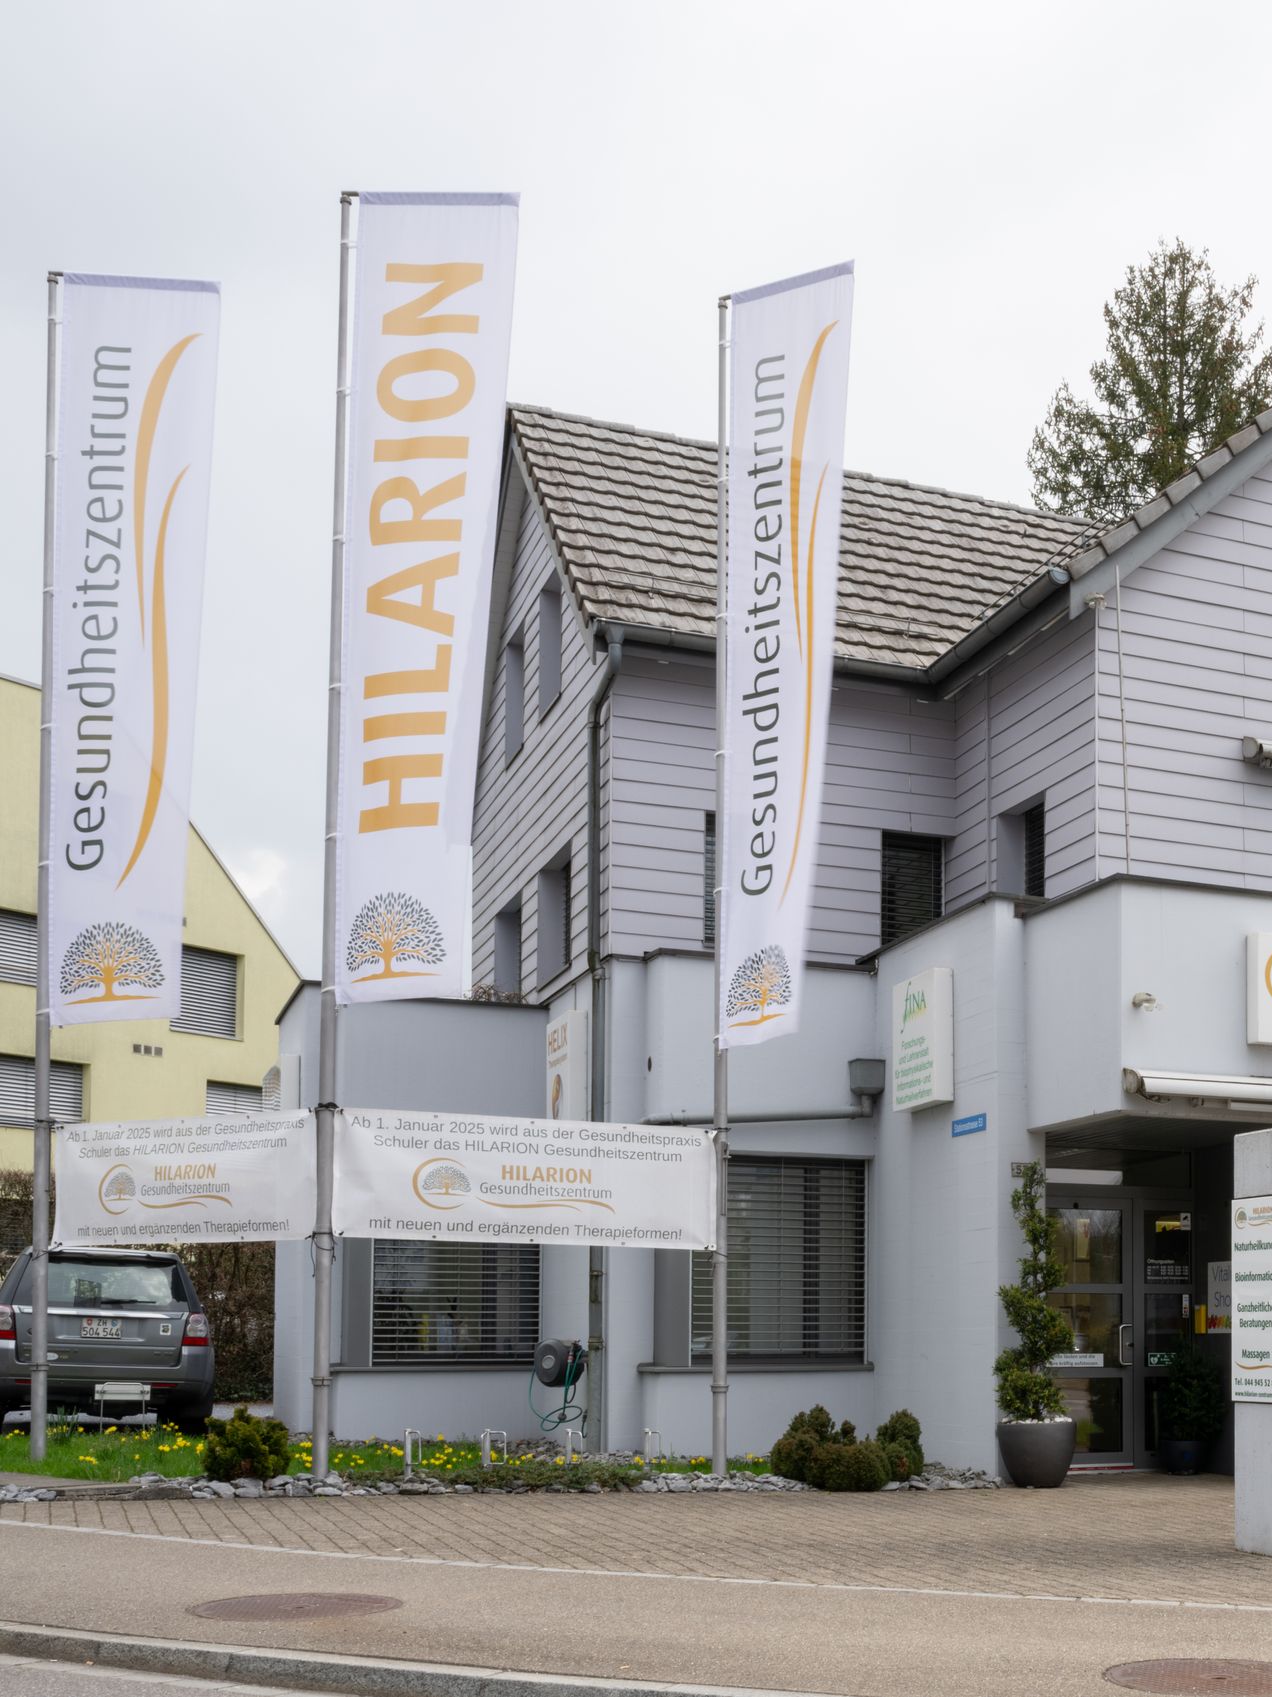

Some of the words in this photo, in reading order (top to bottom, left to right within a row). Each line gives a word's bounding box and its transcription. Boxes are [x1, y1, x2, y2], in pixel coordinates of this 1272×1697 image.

[357, 261, 485, 835] HILARION
[65, 345, 132, 872] Gesundheitszentrum
[740, 353, 786, 896] Gesundheitszentrum
[66, 1130, 80, 1143] Ab
[82, 1131, 90, 1142] 1.
[92, 1129, 125, 1142] Januar
[127, 1127, 150, 1140] 2025
[153, 1125, 173, 1139] wird
[175, 1126, 193, 1137] aus
[195, 1124, 211, 1136] der
[214, 1118, 305, 1135] Gesundheitspraxis
[351, 1116, 371, 1129] Ab
[376, 1117, 389, 1130] 1.
[394, 1118, 445, 1133] Januar
[450, 1121, 485, 1135] 2025
[489, 1125, 518, 1137] wird
[523, 1128, 548, 1138] aus
[552, 1127, 574, 1140] der
[579, 1129, 702, 1148] Gesundheitspraxis
[79, 1147, 113, 1159] Schuler
[114, 1145, 131, 1157] das
[133, 1142, 185, 1156] HILARION
[188, 1137, 287, 1154] Gesundheitszentrum
[373, 1135, 430, 1150] Schuler
[434, 1138, 460, 1151] das
[465, 1140, 539, 1155] HILARION
[544, 1143, 682, 1163] Gesundheitszentrum
[154, 1163, 217, 1182] HILARION
[501, 1164, 592, 1184] HILARION
[140, 1181, 230, 1197] Gesundheitszentrum
[480, 1182, 612, 1199] Gesundheitszentrum
[77, 1225, 90, 1237] mit
[92, 1225, 119, 1236] neuen
[121, 1222, 137, 1235] und
[139, 1221, 201, 1239] ergänzenden
[203, 1218, 290, 1237] Therapieformen!
[369, 1217, 392, 1229] mit
[396, 1218, 442, 1231] neuen
[446, 1220, 473, 1233] und
[478, 1221, 569, 1236] ergänzenden
[574, 1224, 682, 1240] Therapieformen!
[1214, 1292, 1231, 1308] Sho
[82, 1327, 100, 1336] 504
[102, 1327, 120, 1337] 544
[97, 1319, 108, 1327] ZH
[1239, 1318, 1272, 1331] Beratungen
[1241, 1348, 1271, 1361] Massagen
[1235, 1378, 1243, 1386] Tel.
[1244, 1378, 1253, 1386] 044
[1254, 1379, 1263, 1387] 945
[1264, 1379, 1270, 1387] 52
